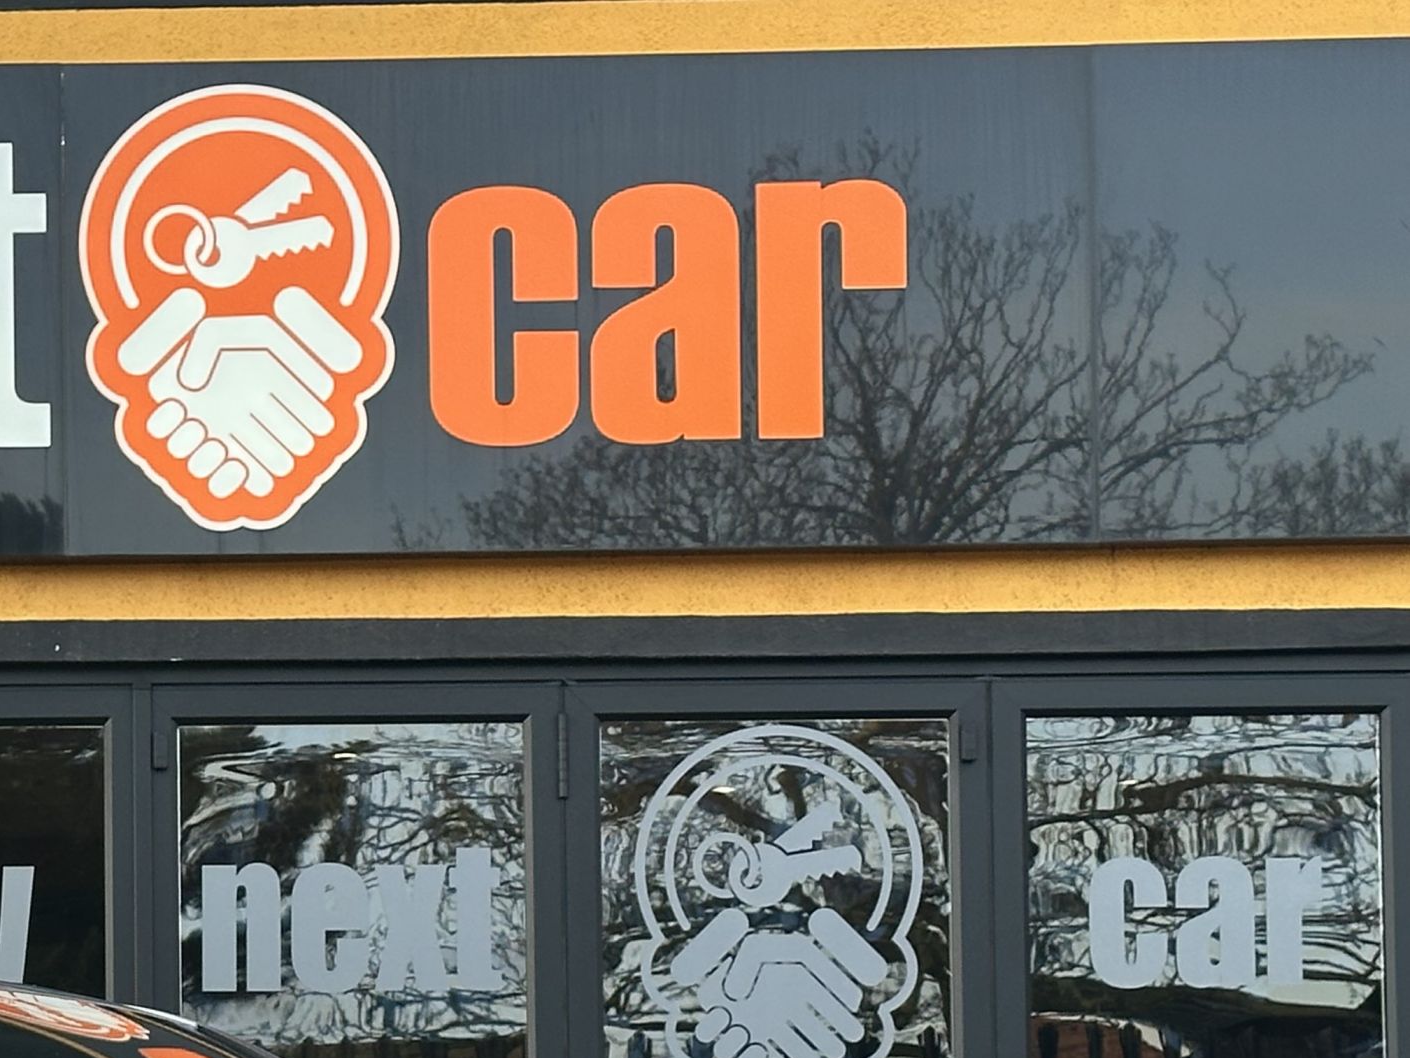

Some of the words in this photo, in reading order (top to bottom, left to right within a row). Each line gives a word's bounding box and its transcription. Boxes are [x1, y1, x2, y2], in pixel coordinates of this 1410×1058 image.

[428, 179, 908, 447] car
[201, 847, 505, 993] next
[1089, 855, 1325, 991] car
